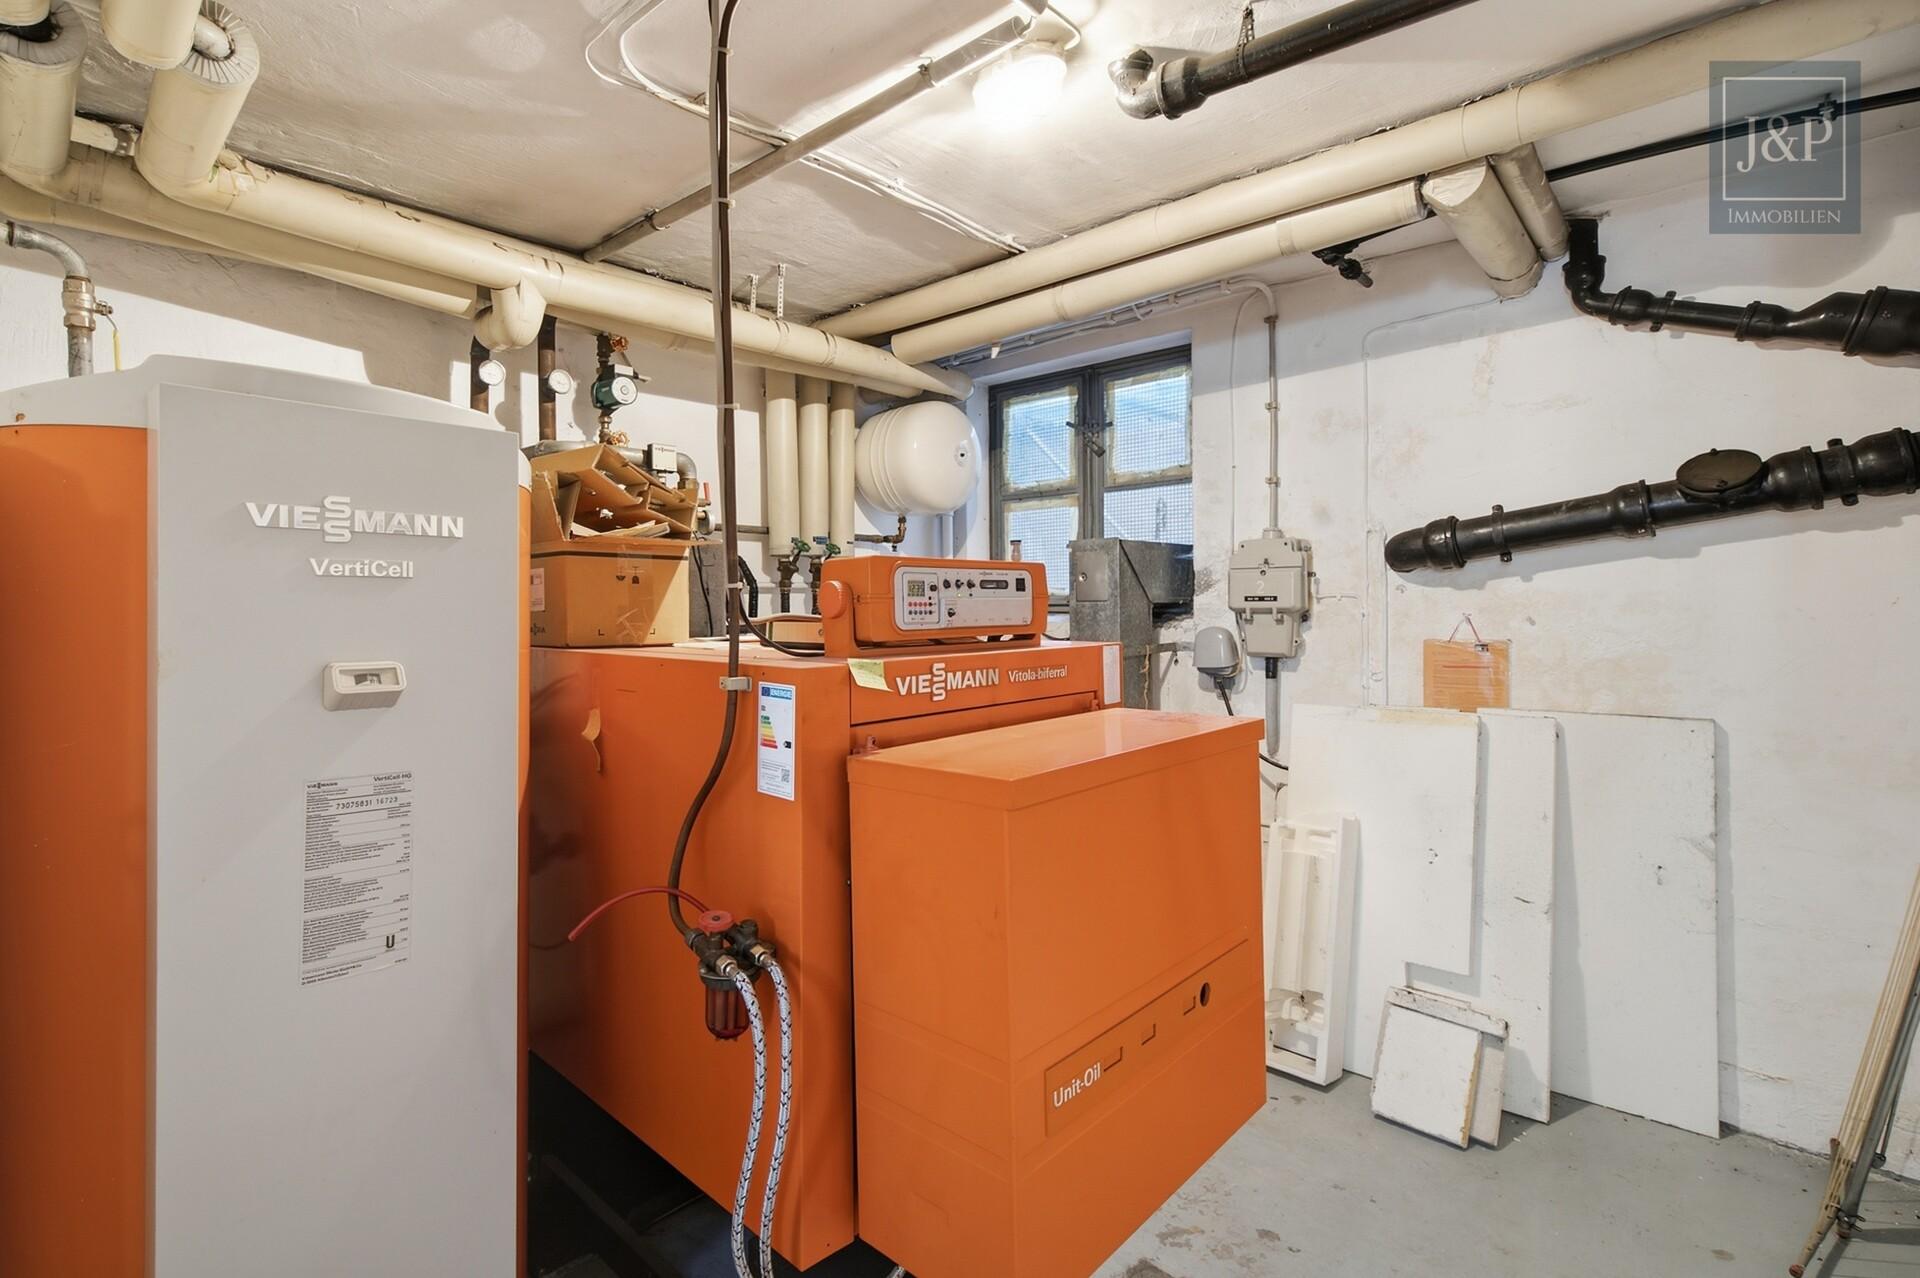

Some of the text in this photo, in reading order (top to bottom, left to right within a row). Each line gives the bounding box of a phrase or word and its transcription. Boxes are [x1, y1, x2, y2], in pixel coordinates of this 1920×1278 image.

[245, 495, 464, 543] VIESSMANN
[309, 557, 414, 578] VertiCell
[1256, 580, 1265, 594] 2
[895, 663, 1000, 702] VIESSMANN
[1008, 665, 1067, 684] Vitola-biferral
[1053, 1061, 1101, 1108] Unit-Oil
